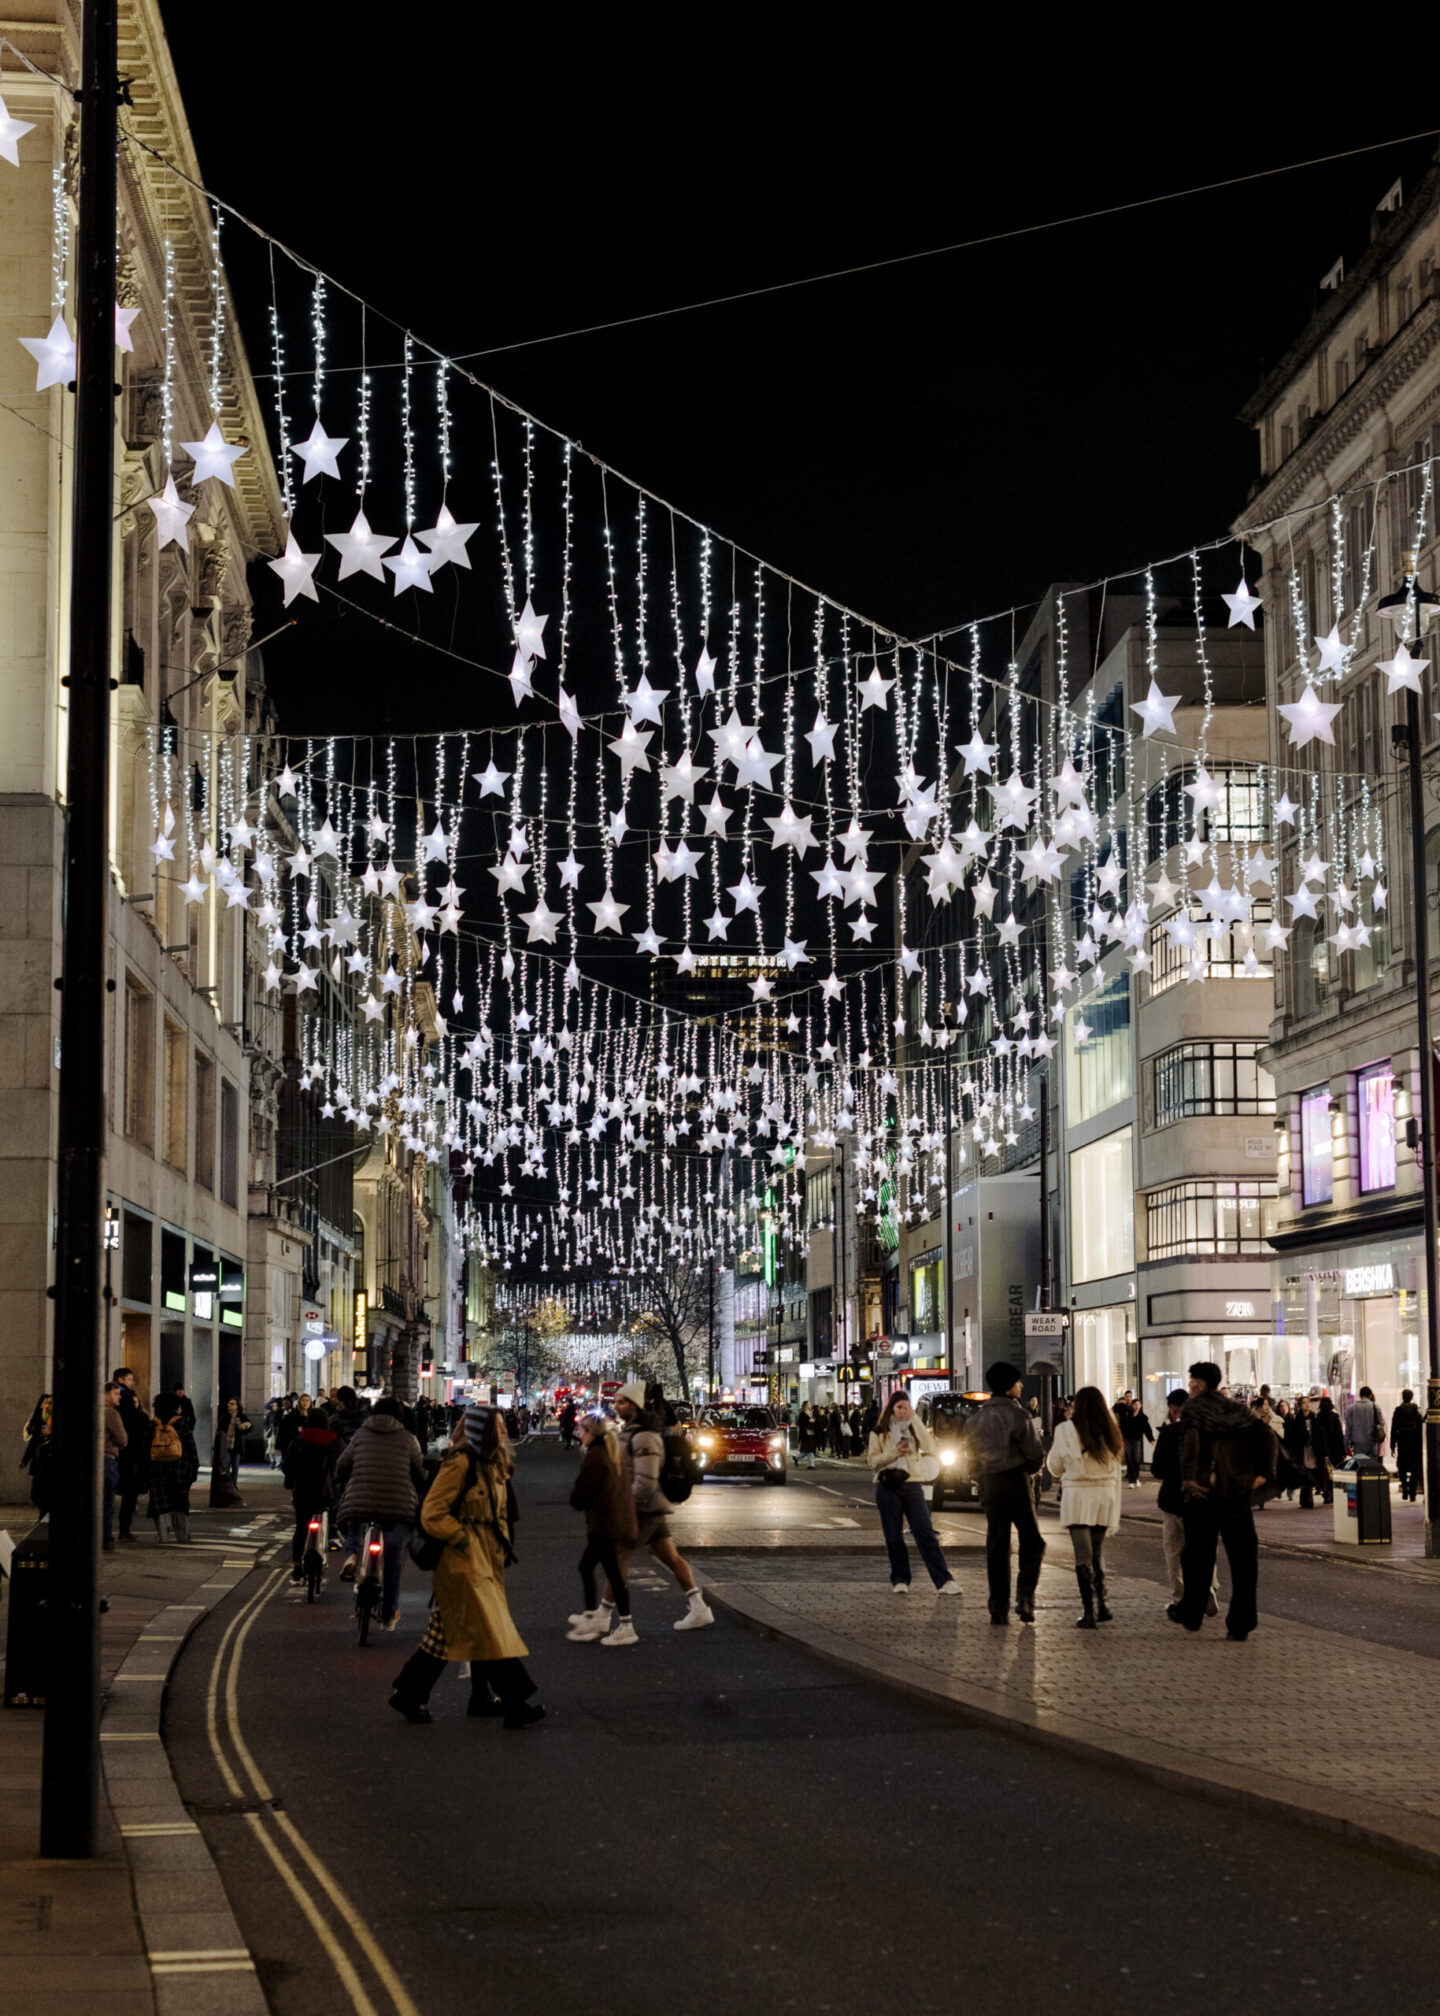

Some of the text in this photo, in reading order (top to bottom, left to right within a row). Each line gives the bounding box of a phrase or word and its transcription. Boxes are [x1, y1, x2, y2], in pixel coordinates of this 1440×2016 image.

[748, 956, 787, 967] POIN
[1345, 1263, 1393, 1294] BERSHKA
[1225, 1301, 1254, 1317] ZARA
[1009, 1284, 1023, 1368] ULL&BEAR
